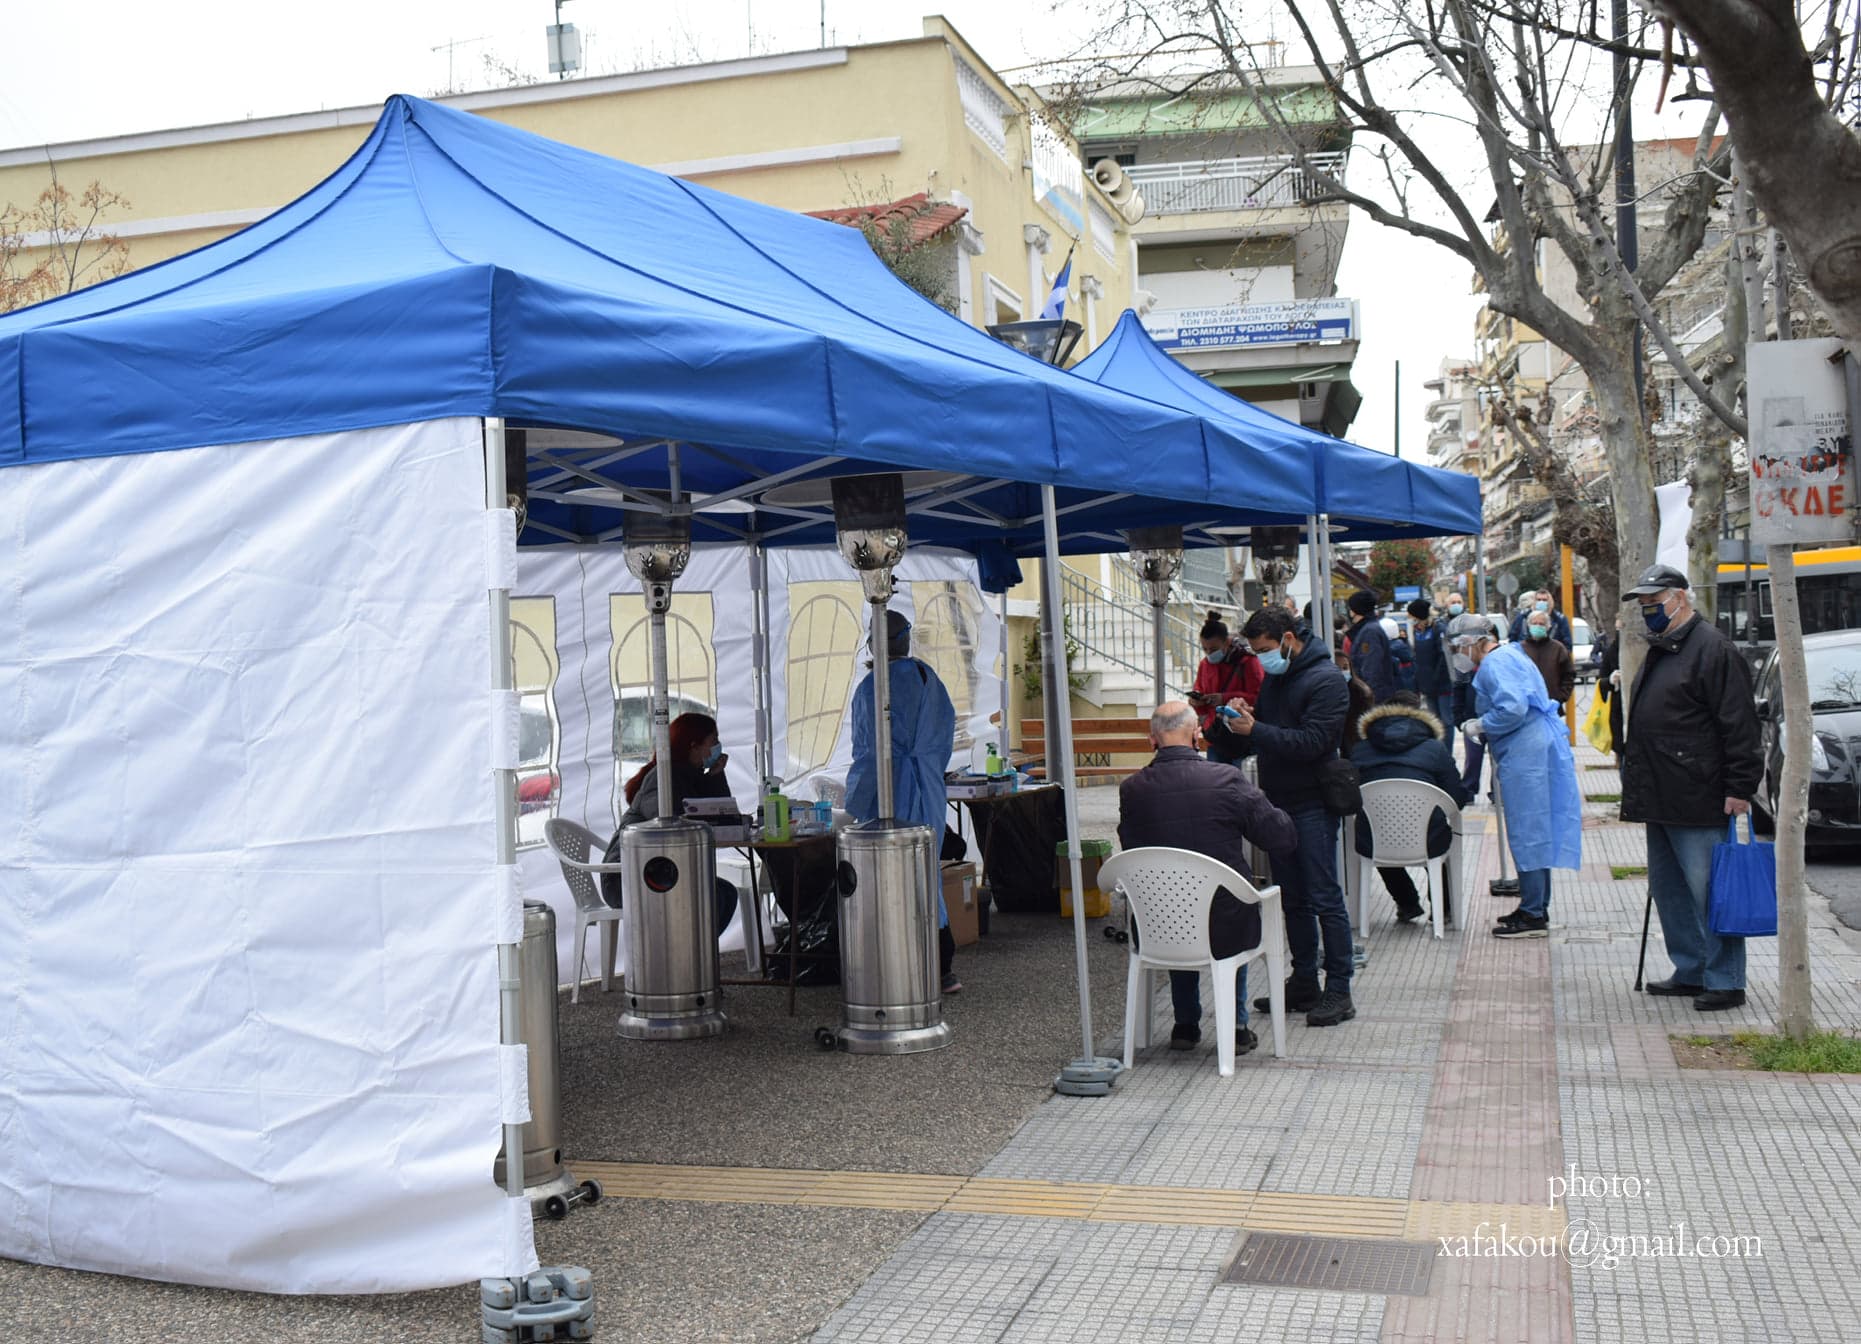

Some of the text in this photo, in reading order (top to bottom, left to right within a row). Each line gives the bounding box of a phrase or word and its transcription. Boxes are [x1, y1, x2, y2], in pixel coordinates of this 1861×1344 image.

[1180, 309, 1217, 318] ΚΕΝΤΡΟ
[1220, 306, 1272, 316] ΔΙΑΓΝΩΣΗΣ
[1181, 318, 1200, 326] ΤΩΝ
[1202, 314, 1261, 325] ΔΙΑΤΑΡΑΧΩΝ
[1181, 326, 1236, 337] ΔΙΟΜΗΔΗΣ
[1181, 338, 1198, 346] ΤΗΛ.
[1200, 337, 1219, 345] 2310
